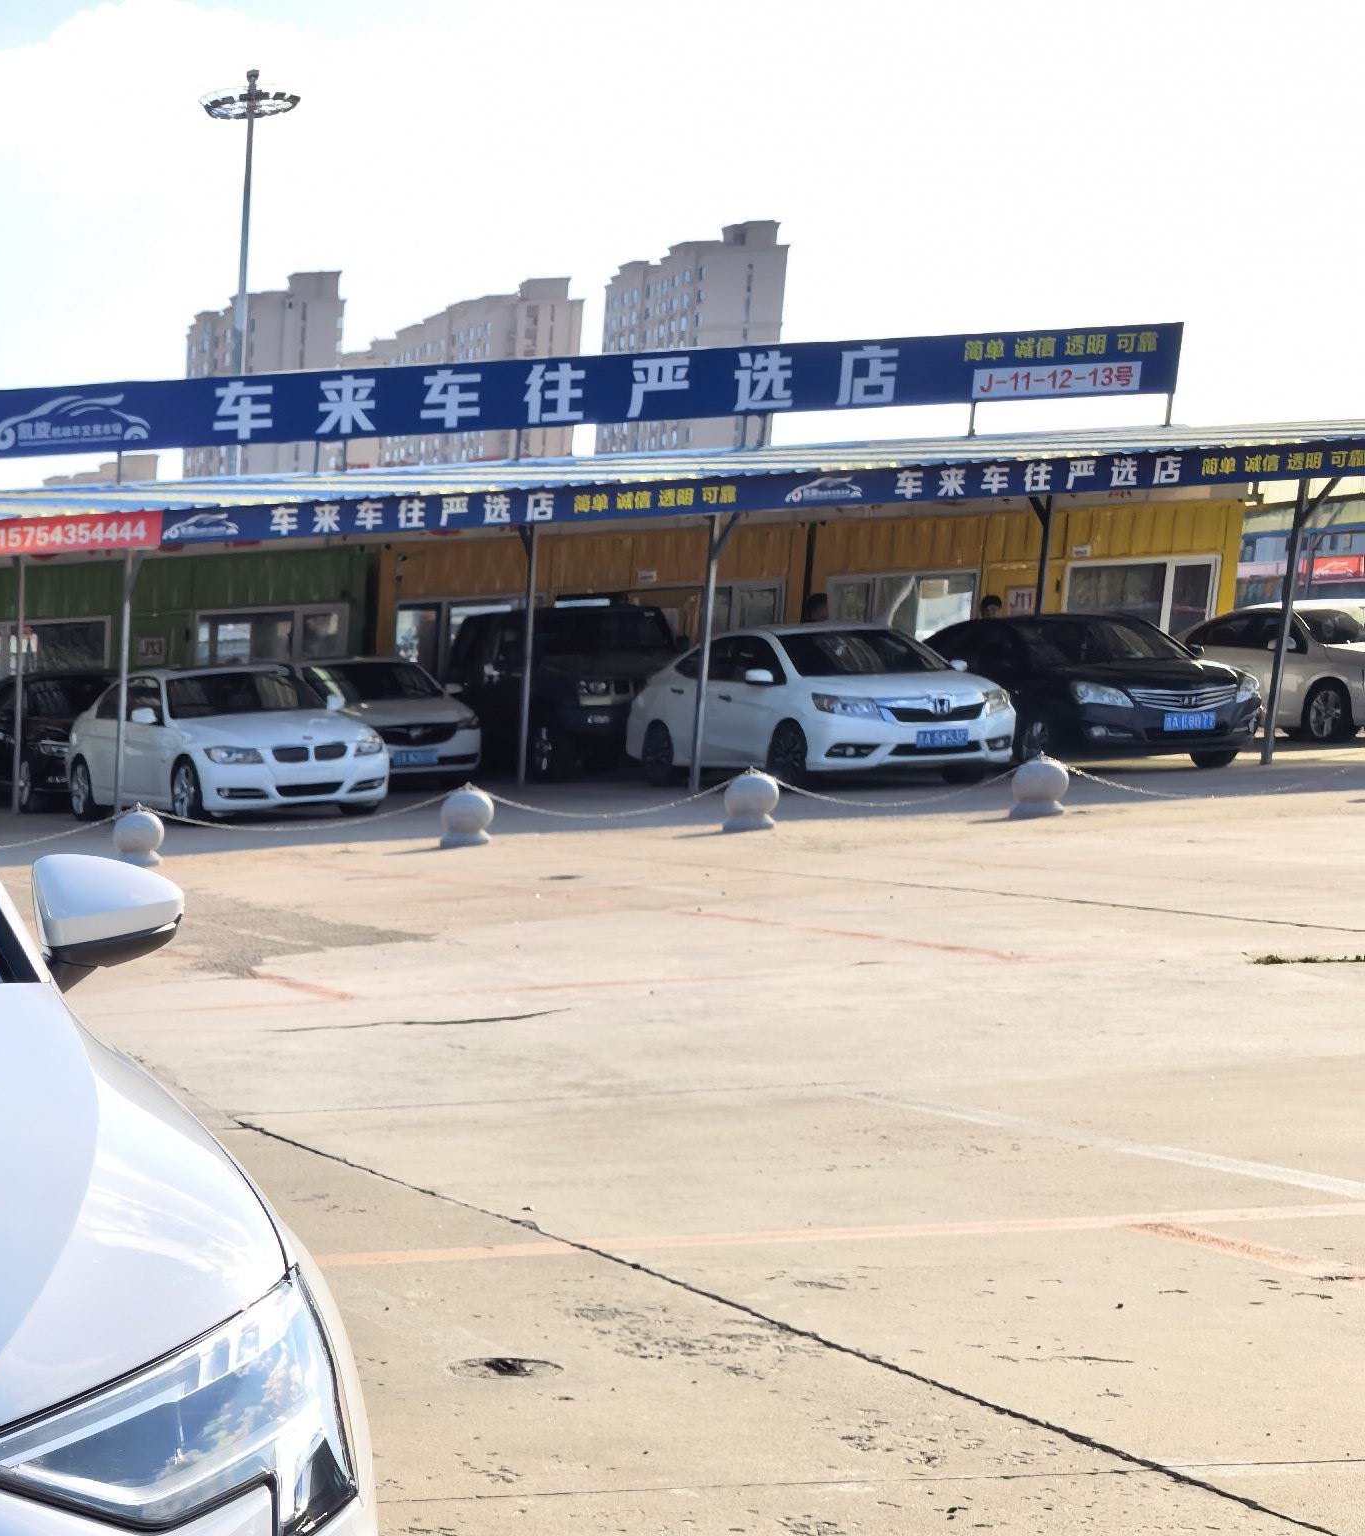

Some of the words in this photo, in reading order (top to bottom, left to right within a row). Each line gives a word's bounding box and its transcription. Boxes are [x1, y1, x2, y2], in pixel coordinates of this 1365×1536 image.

[964, 338, 1004, 361] 简单
[1015, 336, 1056, 358] 诚信
[1064, 334, 1107, 355] 透明
[213, 344, 900, 440] 车来车往严选店
[980, 365, 1133, 393] J-11-12-13号
[895, 455, 1183, 500] 车来车往严选店
[1201, 456, 1236, 476] 简单
[1245, 454, 1280, 473] 诚信
[1287, 451, 1323, 471] 透明
[270, 493, 556, 535] 车来车往严选店
